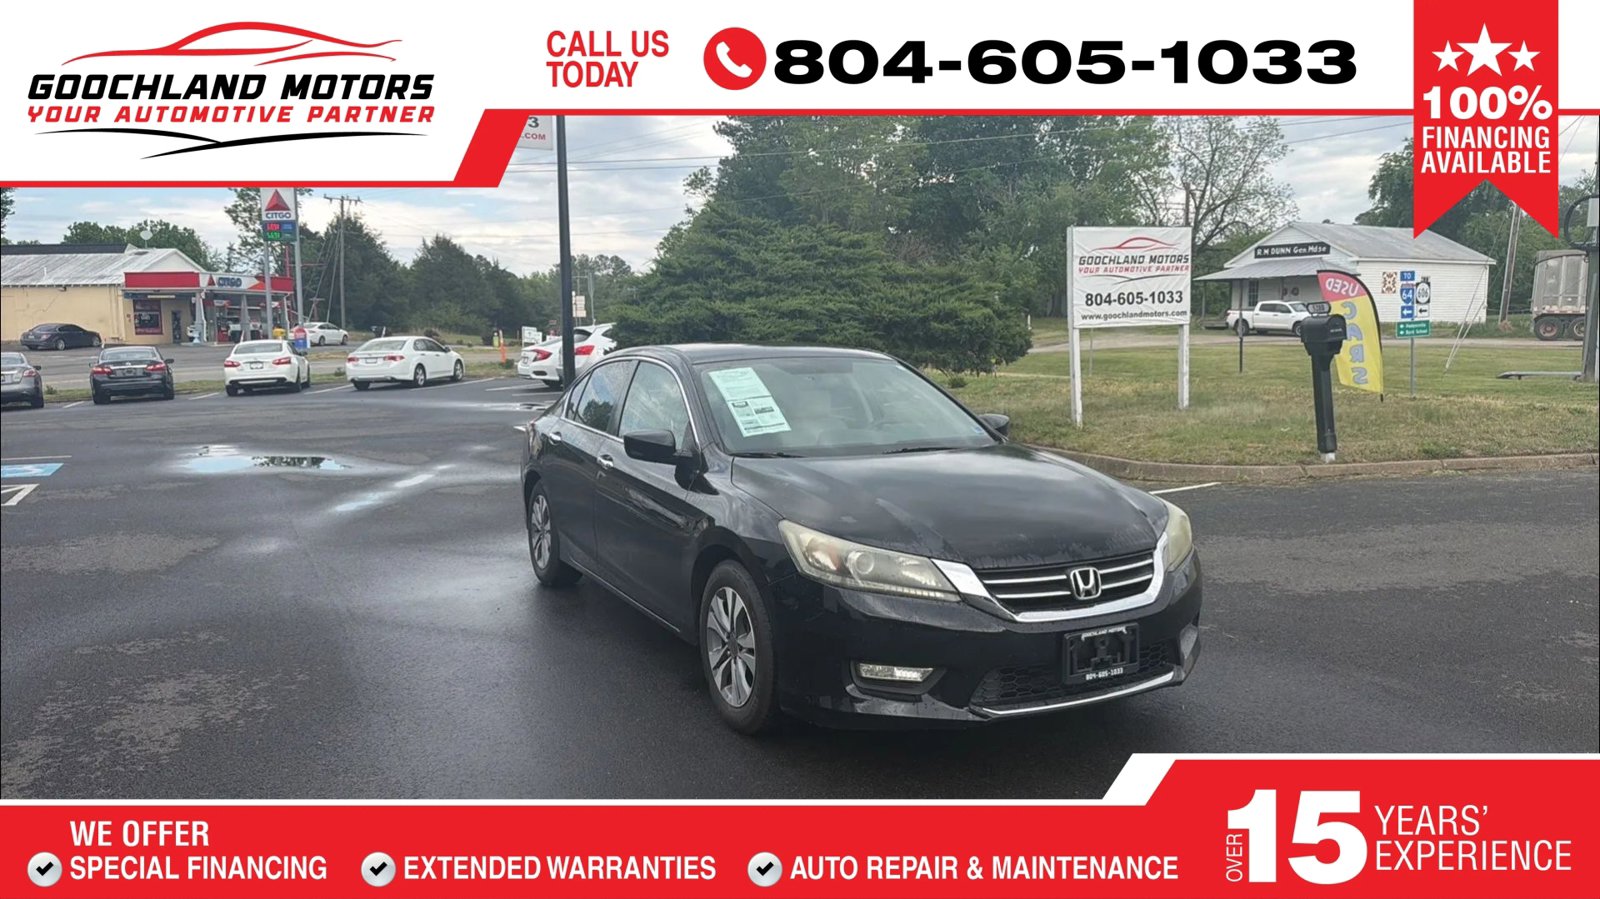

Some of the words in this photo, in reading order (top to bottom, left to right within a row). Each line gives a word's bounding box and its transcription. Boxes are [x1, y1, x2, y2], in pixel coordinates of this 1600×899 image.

[1270, 247, 1292, 255] DUNN
[1079, 256, 1145, 265] GOOCHLAND
[1149, 255, 1189, 264] MOTORS
[1103, 265, 1151, 273] AUTOMOTIVE
[1155, 264, 1190, 272] PARTNER
[217, 277, 242, 287] CITGO
[1085, 291, 1183, 306] 804-605-1033
[1402, 289, 1413, 300] 64
[1081, 310, 1188, 321] www.goochlandmotors.com
